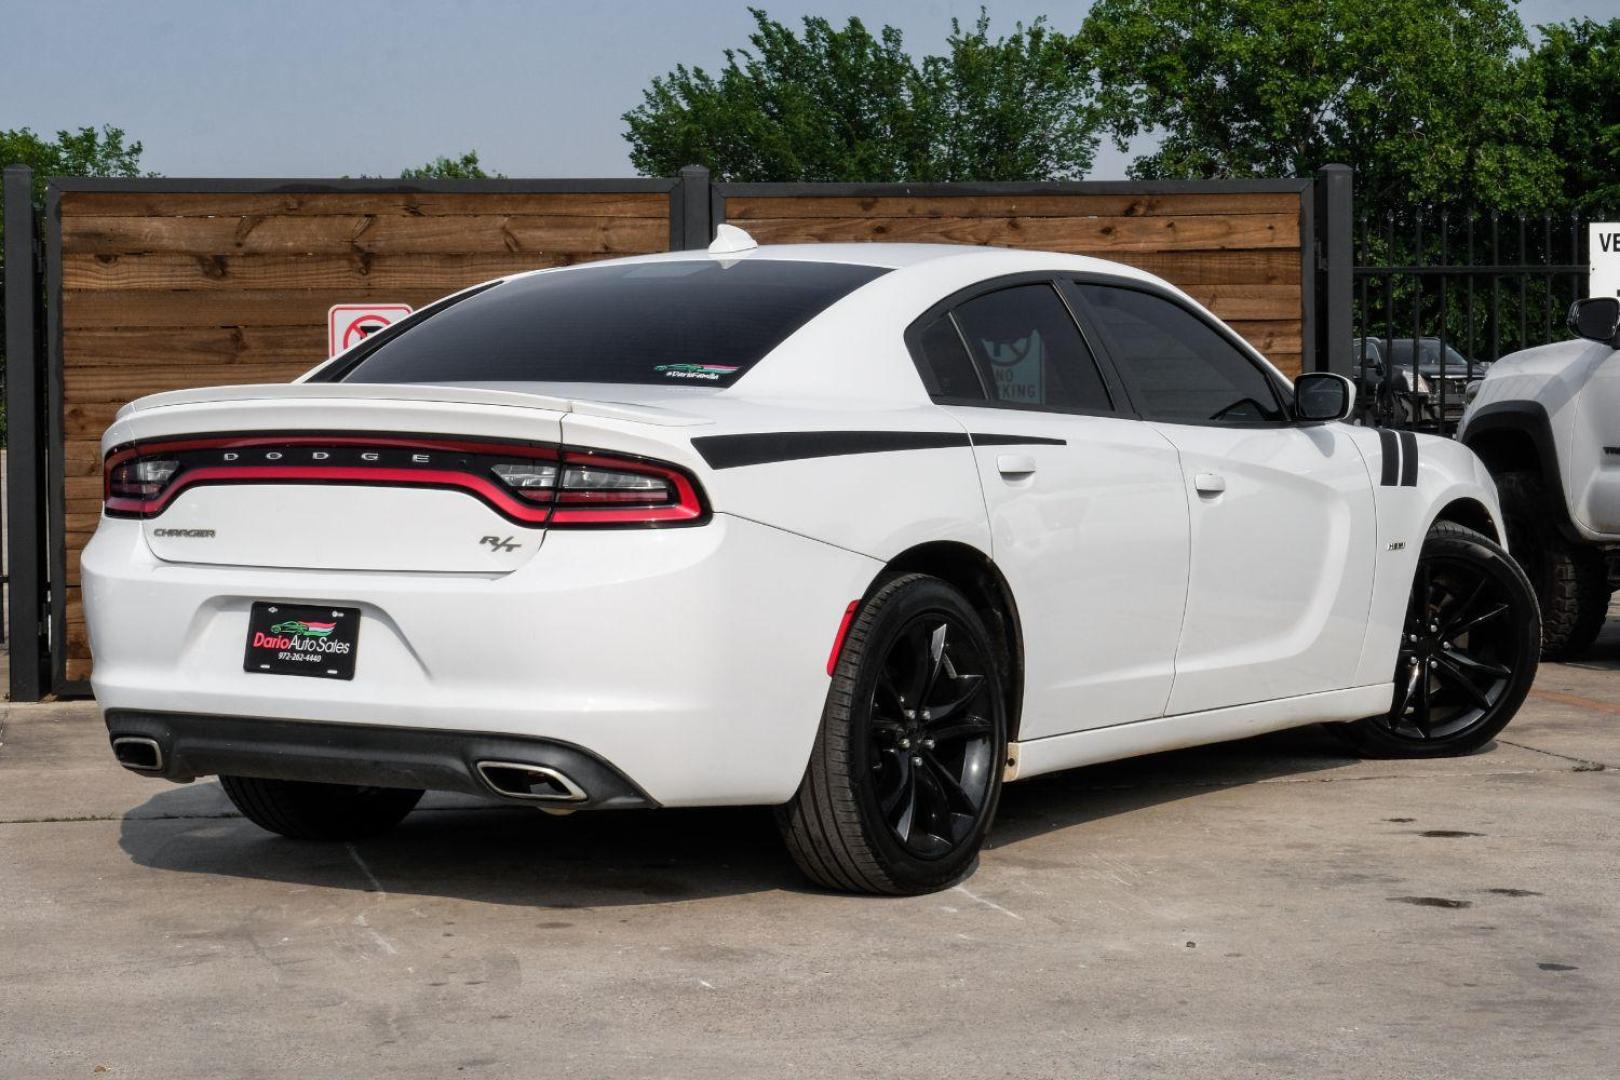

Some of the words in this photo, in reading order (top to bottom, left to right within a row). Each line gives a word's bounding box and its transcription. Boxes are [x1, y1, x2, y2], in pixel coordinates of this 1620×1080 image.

[995, 367, 1014, 382] NO
[1000, 383, 1036, 399] KING
[223, 452, 430, 463] DODGE
[153, 528, 216, 538] CHARGER
[479, 535, 522, 552] R/T
[278, 651, 322, 663] 972-262-4440
